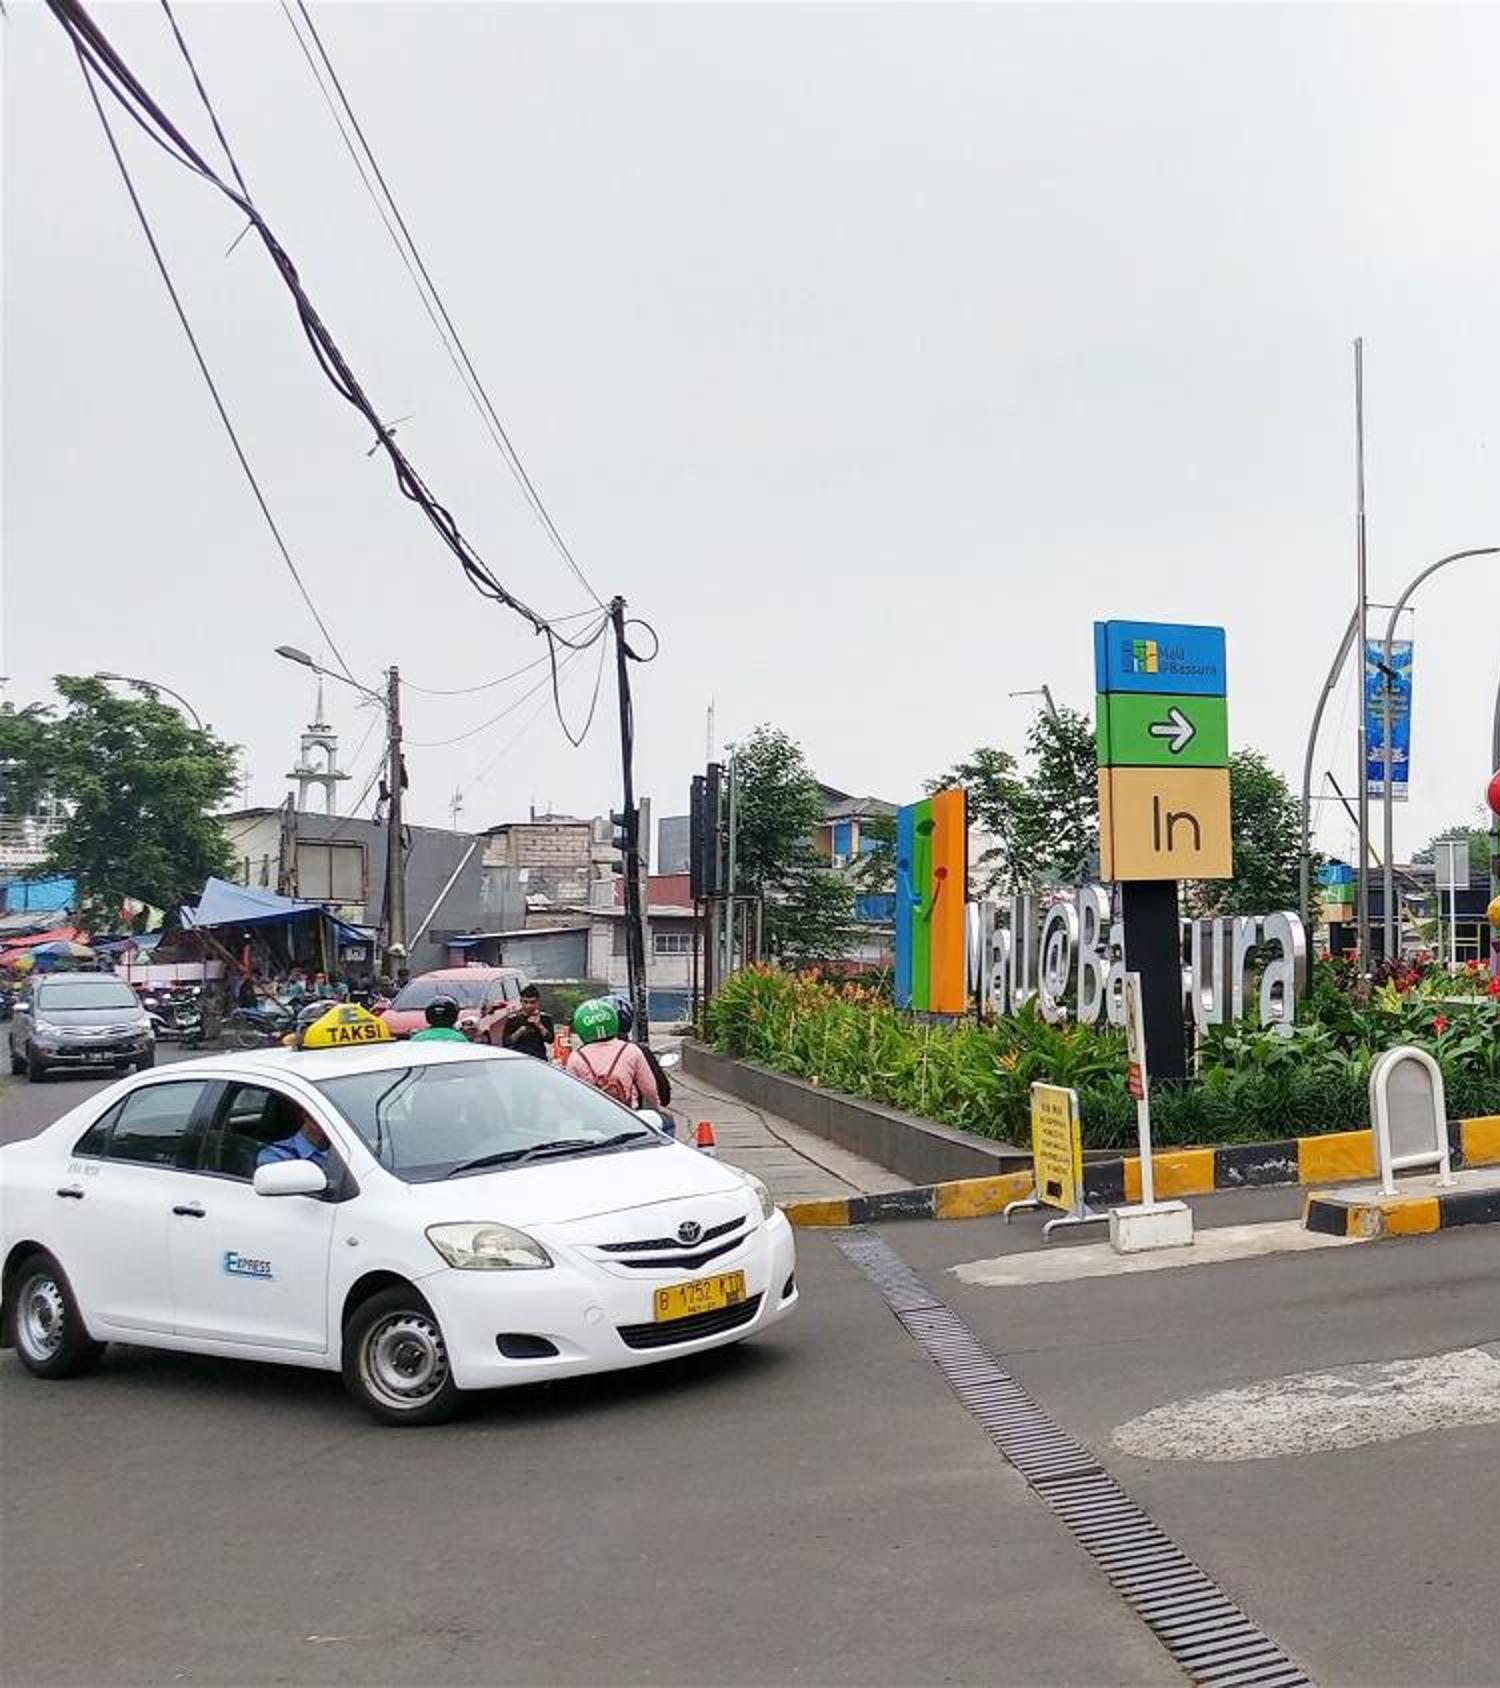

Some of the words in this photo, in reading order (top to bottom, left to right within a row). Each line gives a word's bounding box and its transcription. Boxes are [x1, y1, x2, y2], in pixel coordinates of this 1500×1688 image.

[1153, 795, 1201, 852] In
[965, 884, 1308, 1038] Mall@Baura
[326, 1023, 383, 1042] TAKSI
[660, 1291, 669, 1311] B
